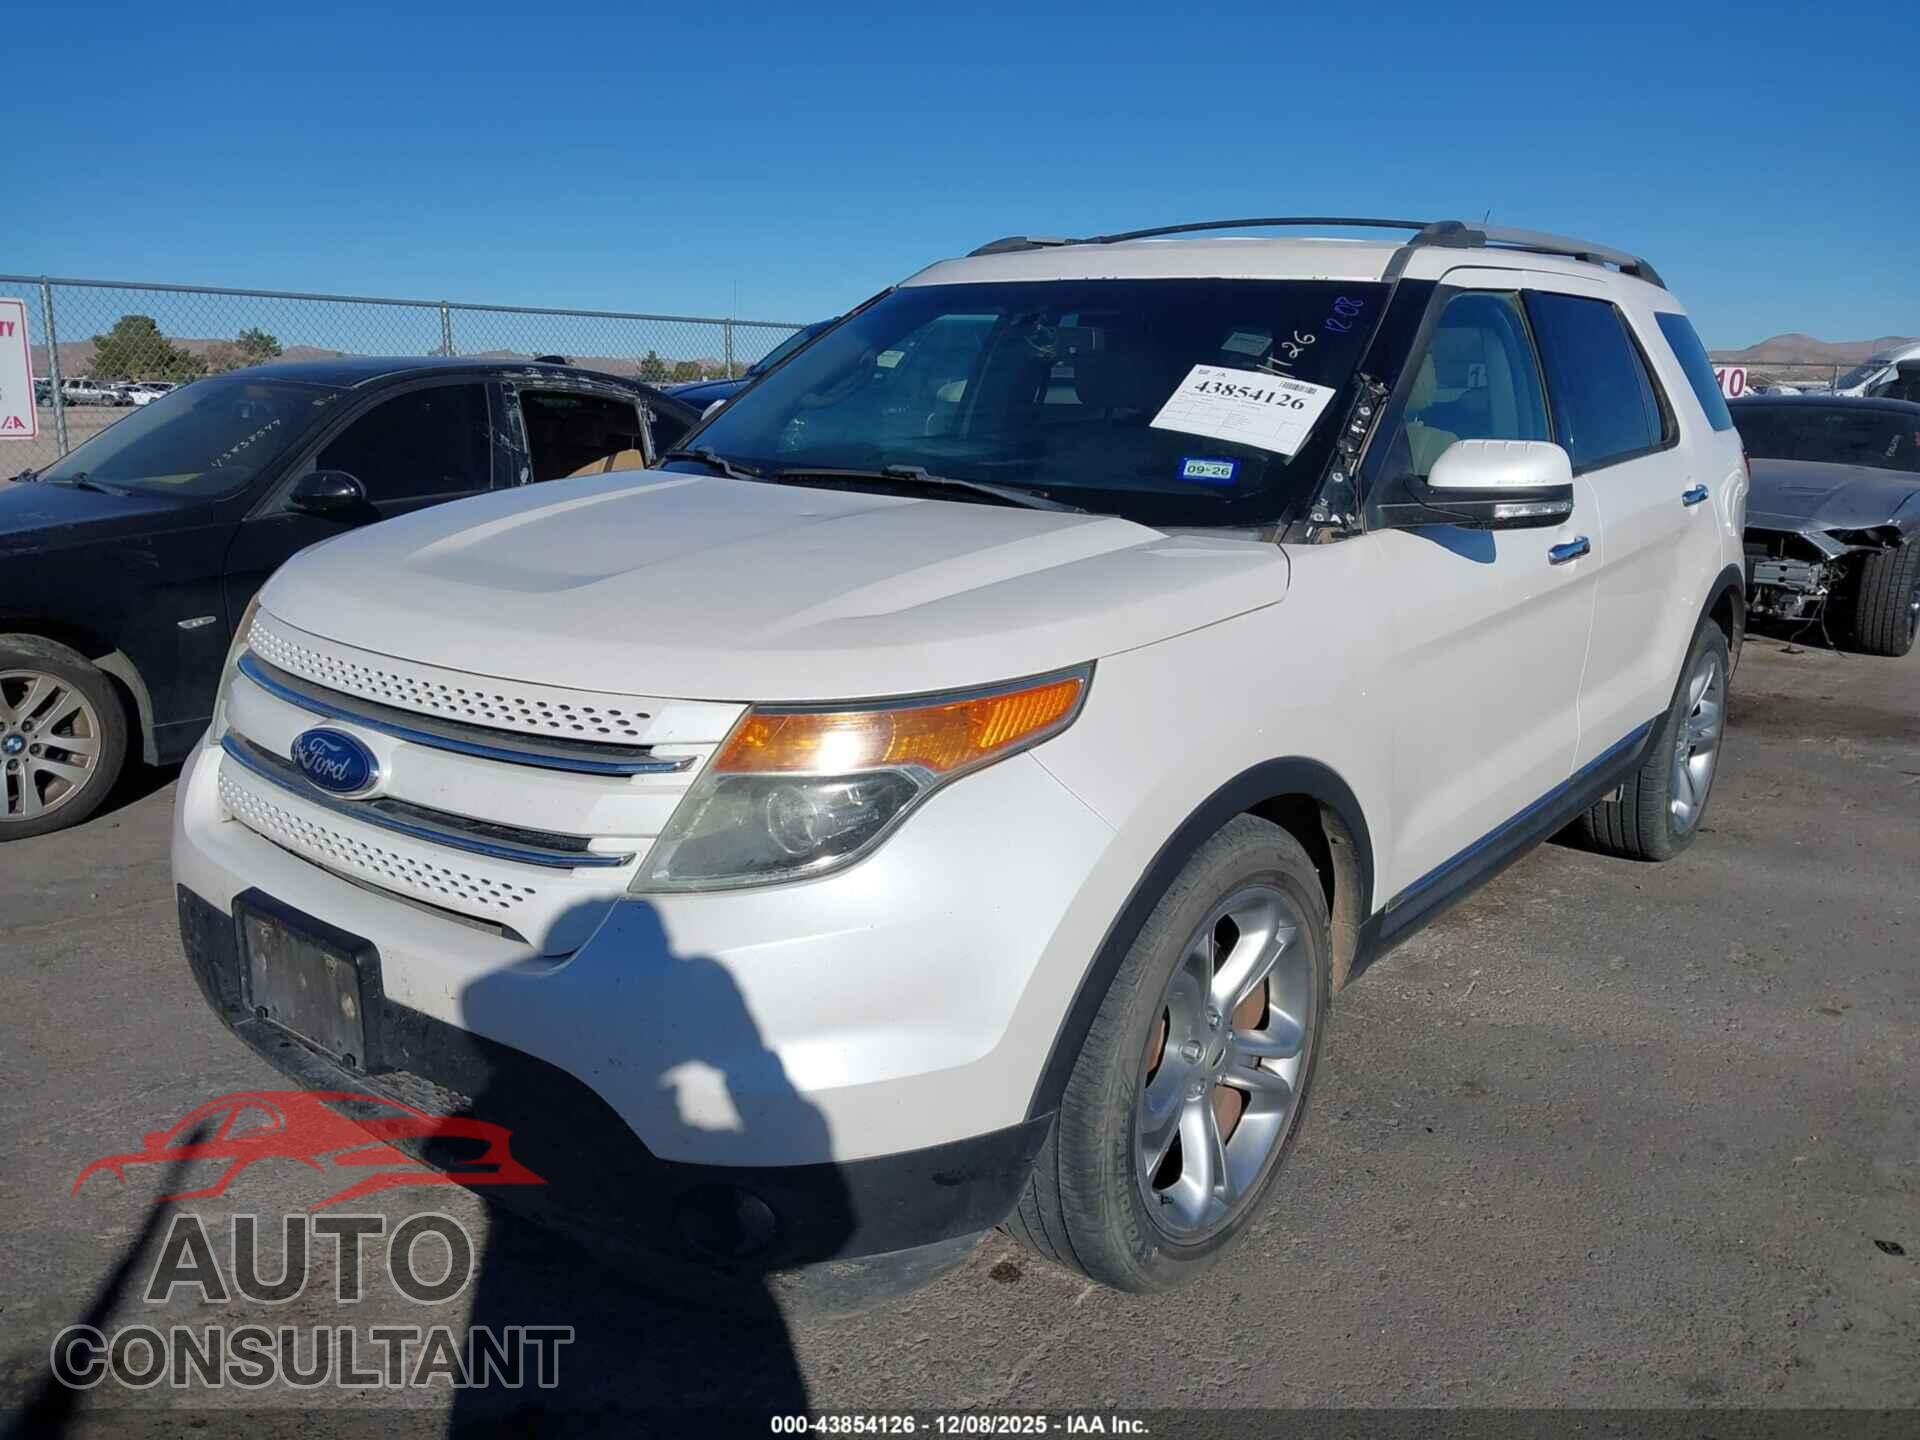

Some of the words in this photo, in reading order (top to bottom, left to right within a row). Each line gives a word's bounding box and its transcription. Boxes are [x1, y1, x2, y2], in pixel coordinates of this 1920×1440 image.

[1194, 380, 1306, 410] 43854126
[1187, 465, 1230, 476] 09-26
[300, 737, 351, 781] Ford
